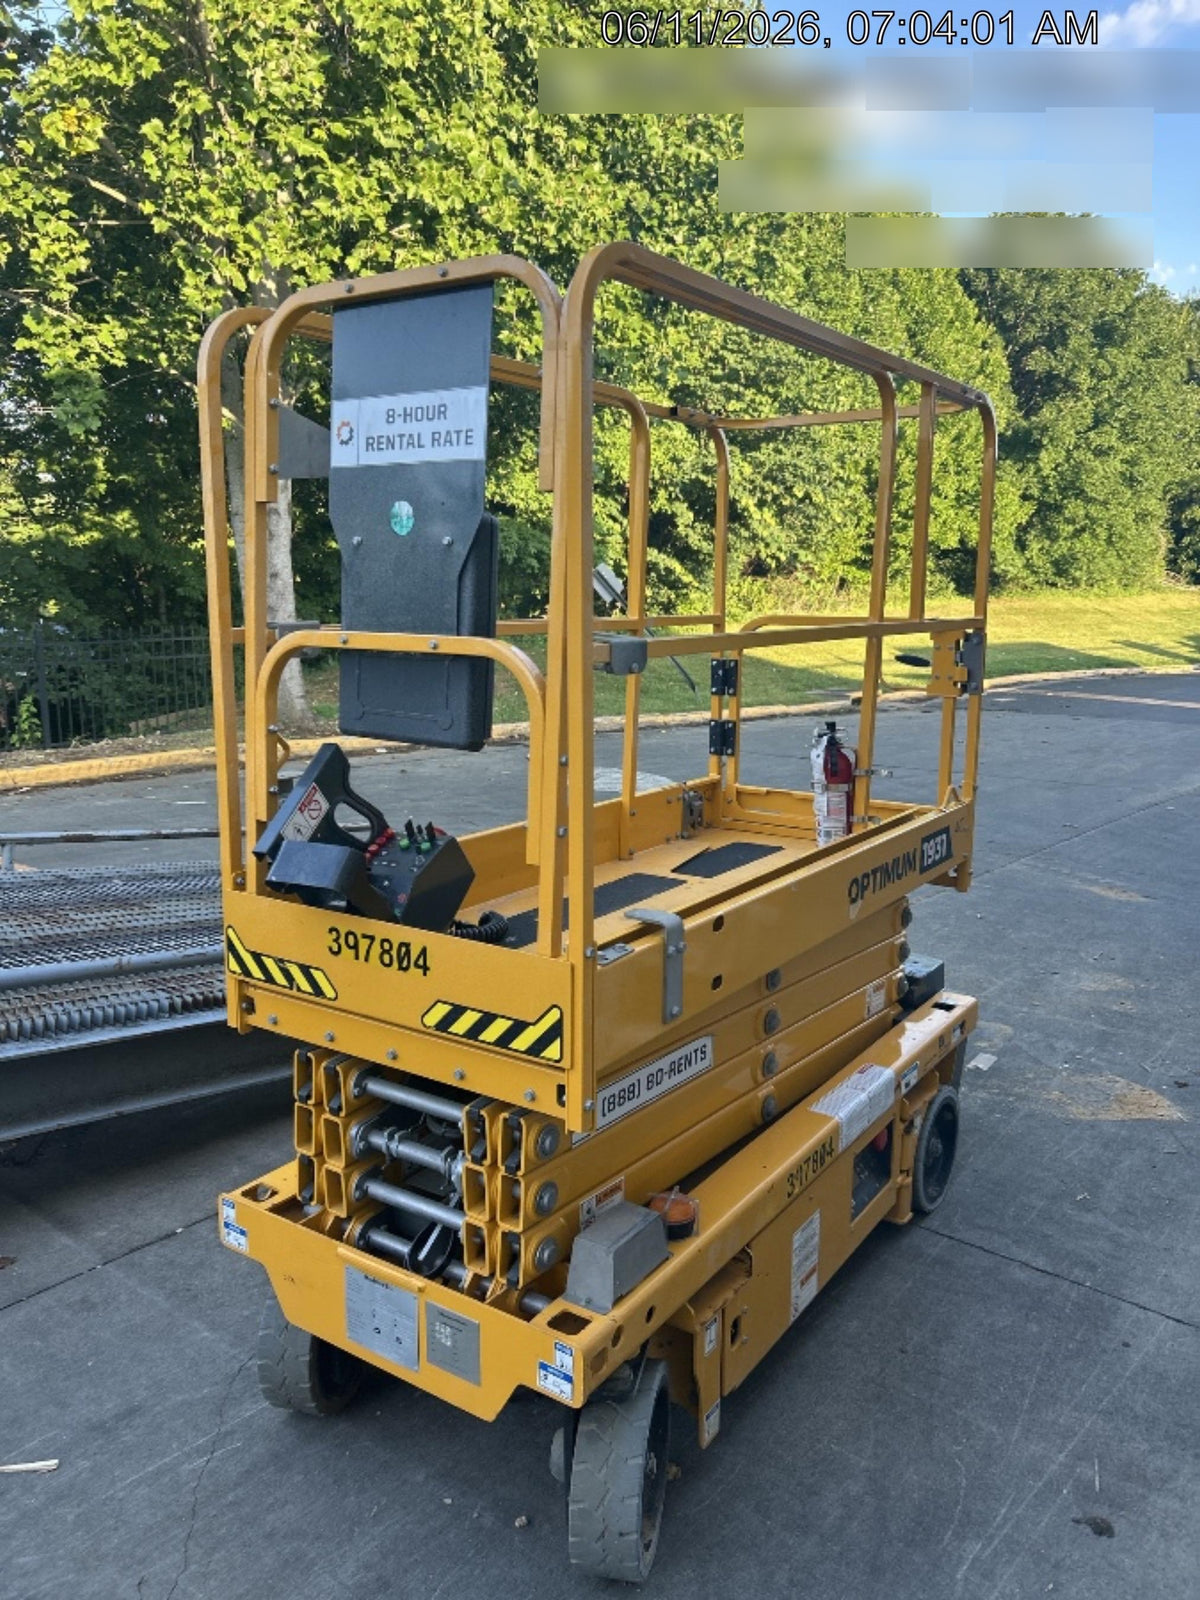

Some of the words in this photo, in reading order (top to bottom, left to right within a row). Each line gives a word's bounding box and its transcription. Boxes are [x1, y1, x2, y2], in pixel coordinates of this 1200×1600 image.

[386, 403, 448, 424] 8-HOUR
[366, 434, 425, 452] RENTAL
[431, 429, 474, 448] RATE
[848, 848, 917, 904] OPTIMUM
[922, 833, 947, 867] 1937
[327, 926, 430, 977] 397804
[601, 1079, 641, 1118] (888)
